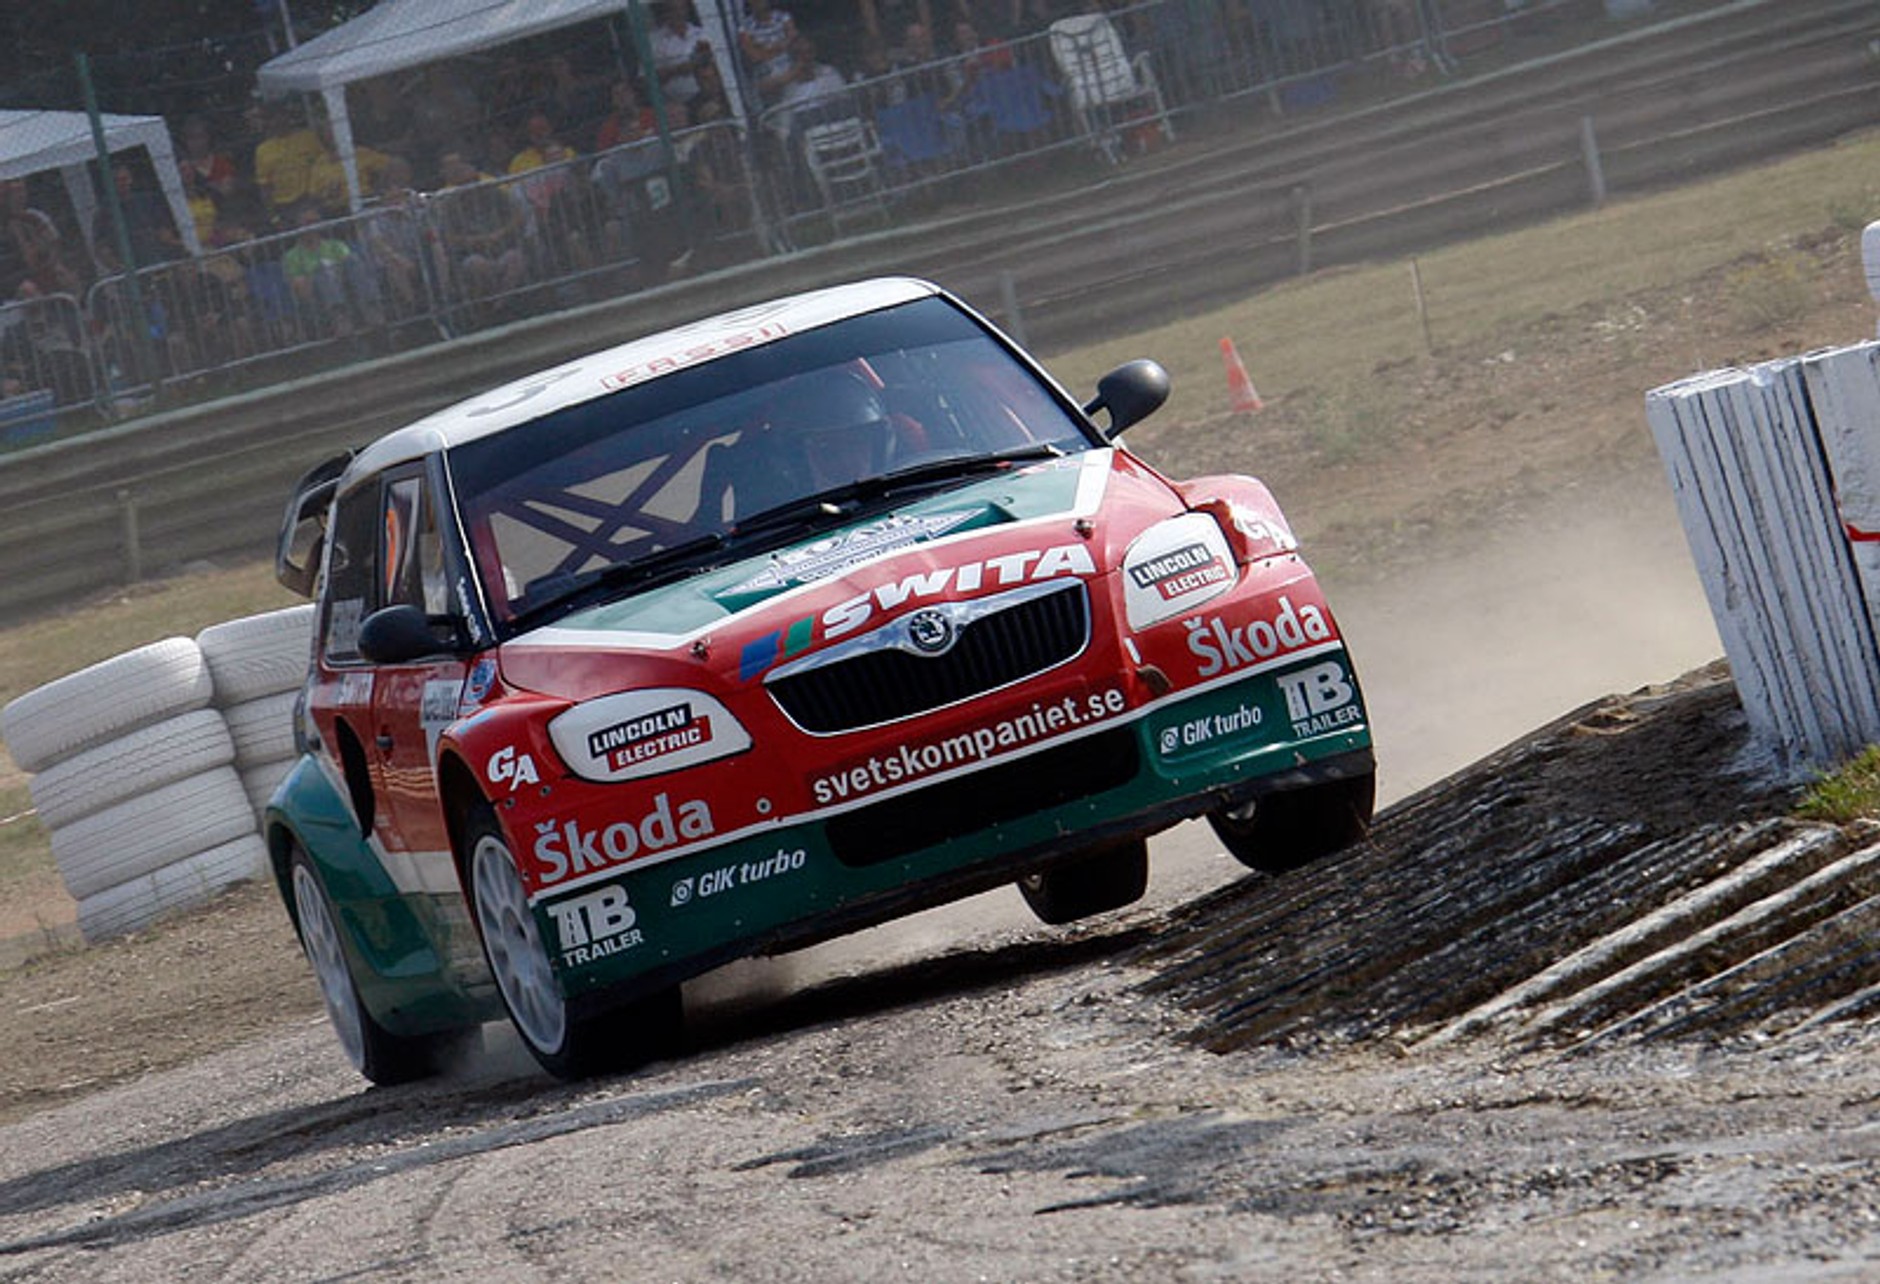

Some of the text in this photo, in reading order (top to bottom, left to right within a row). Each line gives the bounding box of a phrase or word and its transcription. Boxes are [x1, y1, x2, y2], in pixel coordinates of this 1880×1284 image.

[614, 327, 771, 384] FASSI
[1230, 506, 1298, 551] GA
[1133, 546, 1210, 585] LINCOLN
[1163, 563, 1227, 597] ELECTRIC
[822, 543, 1096, 640] SWITA
[1182, 596, 1331, 677] Škoda
[592, 708, 686, 753] LINCOLN
[1183, 704, 1263, 746] GIK turbo
[1292, 704, 1362, 738] TRAILER
[487, 745, 540, 791] GA
[616, 728, 702, 766] ELECTRIC
[812, 688, 1126, 804] svetskompaniet.se
[533, 792, 716, 884] Škoda
[698, 849, 806, 897] GIK turbo
[561, 929, 645, 968] TRAILER
